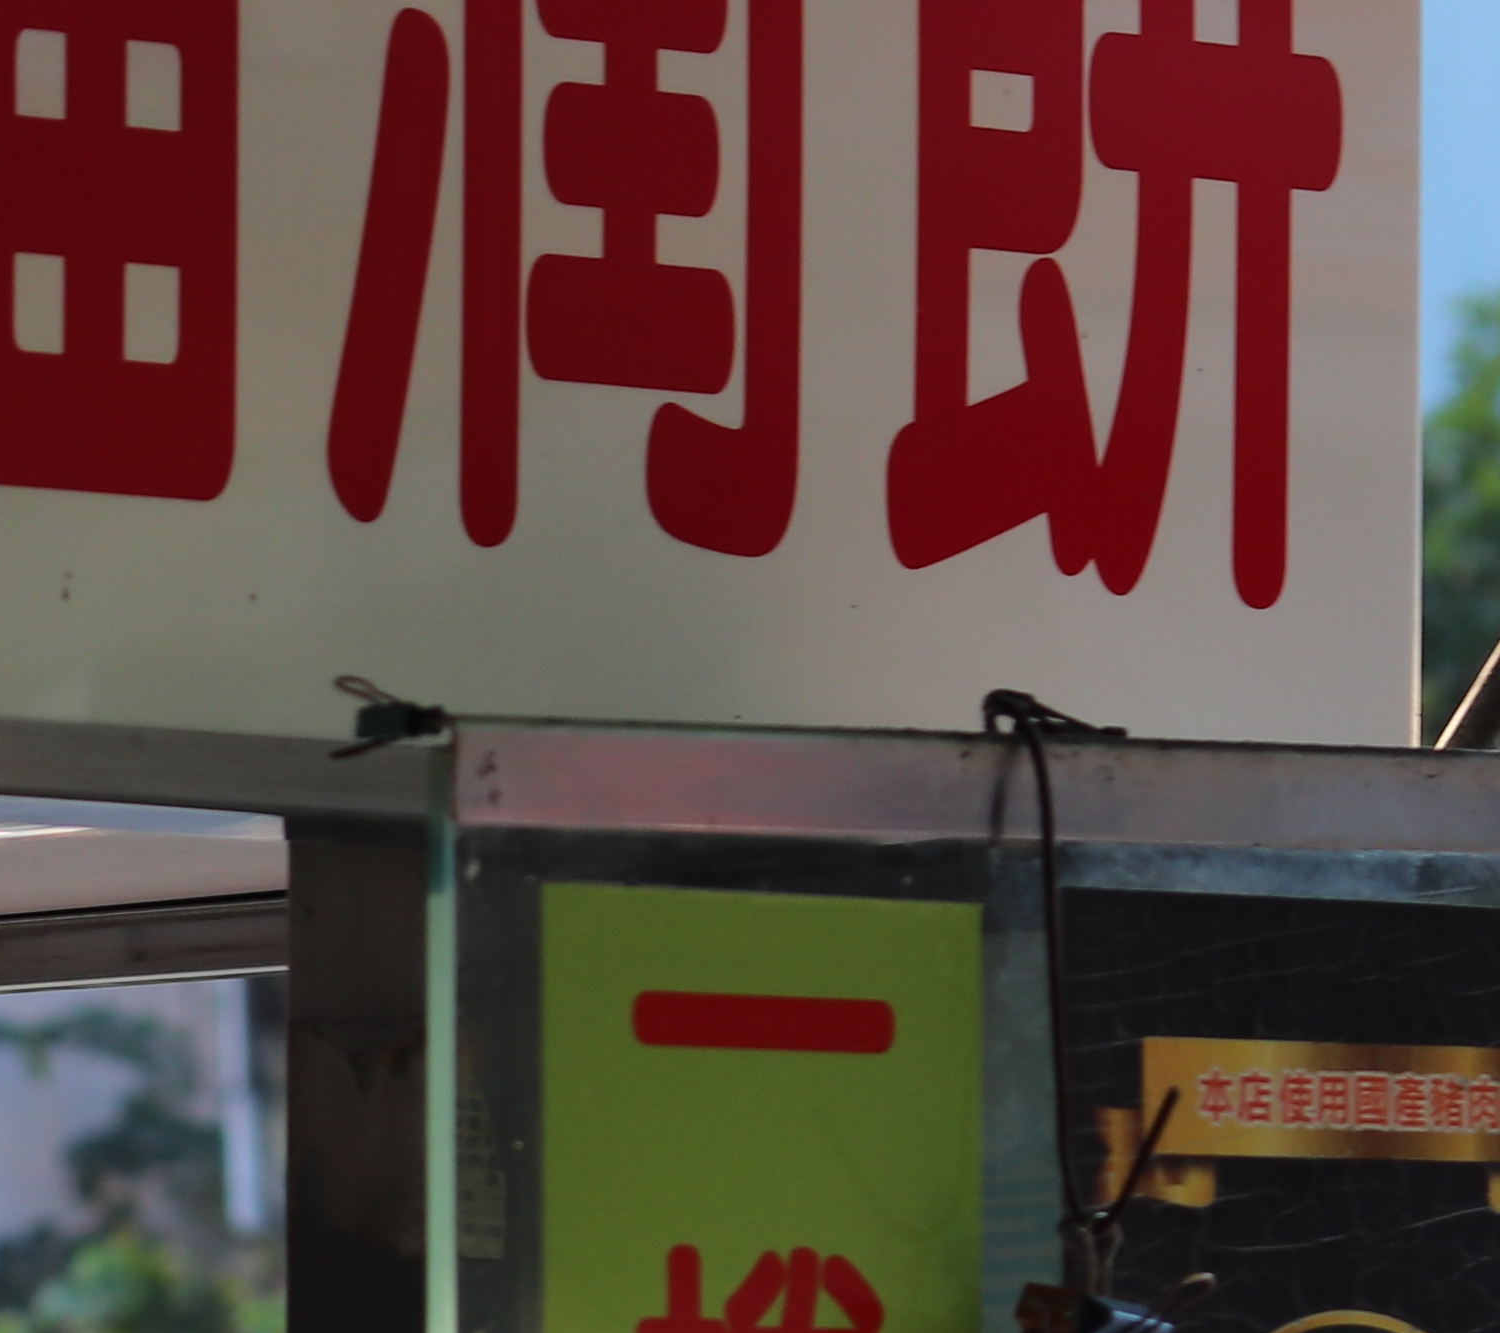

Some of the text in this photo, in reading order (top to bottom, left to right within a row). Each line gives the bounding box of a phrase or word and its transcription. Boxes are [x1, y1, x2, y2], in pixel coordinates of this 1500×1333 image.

[1197, 1066, 1500, 1135] 本店使用國產豬肉
